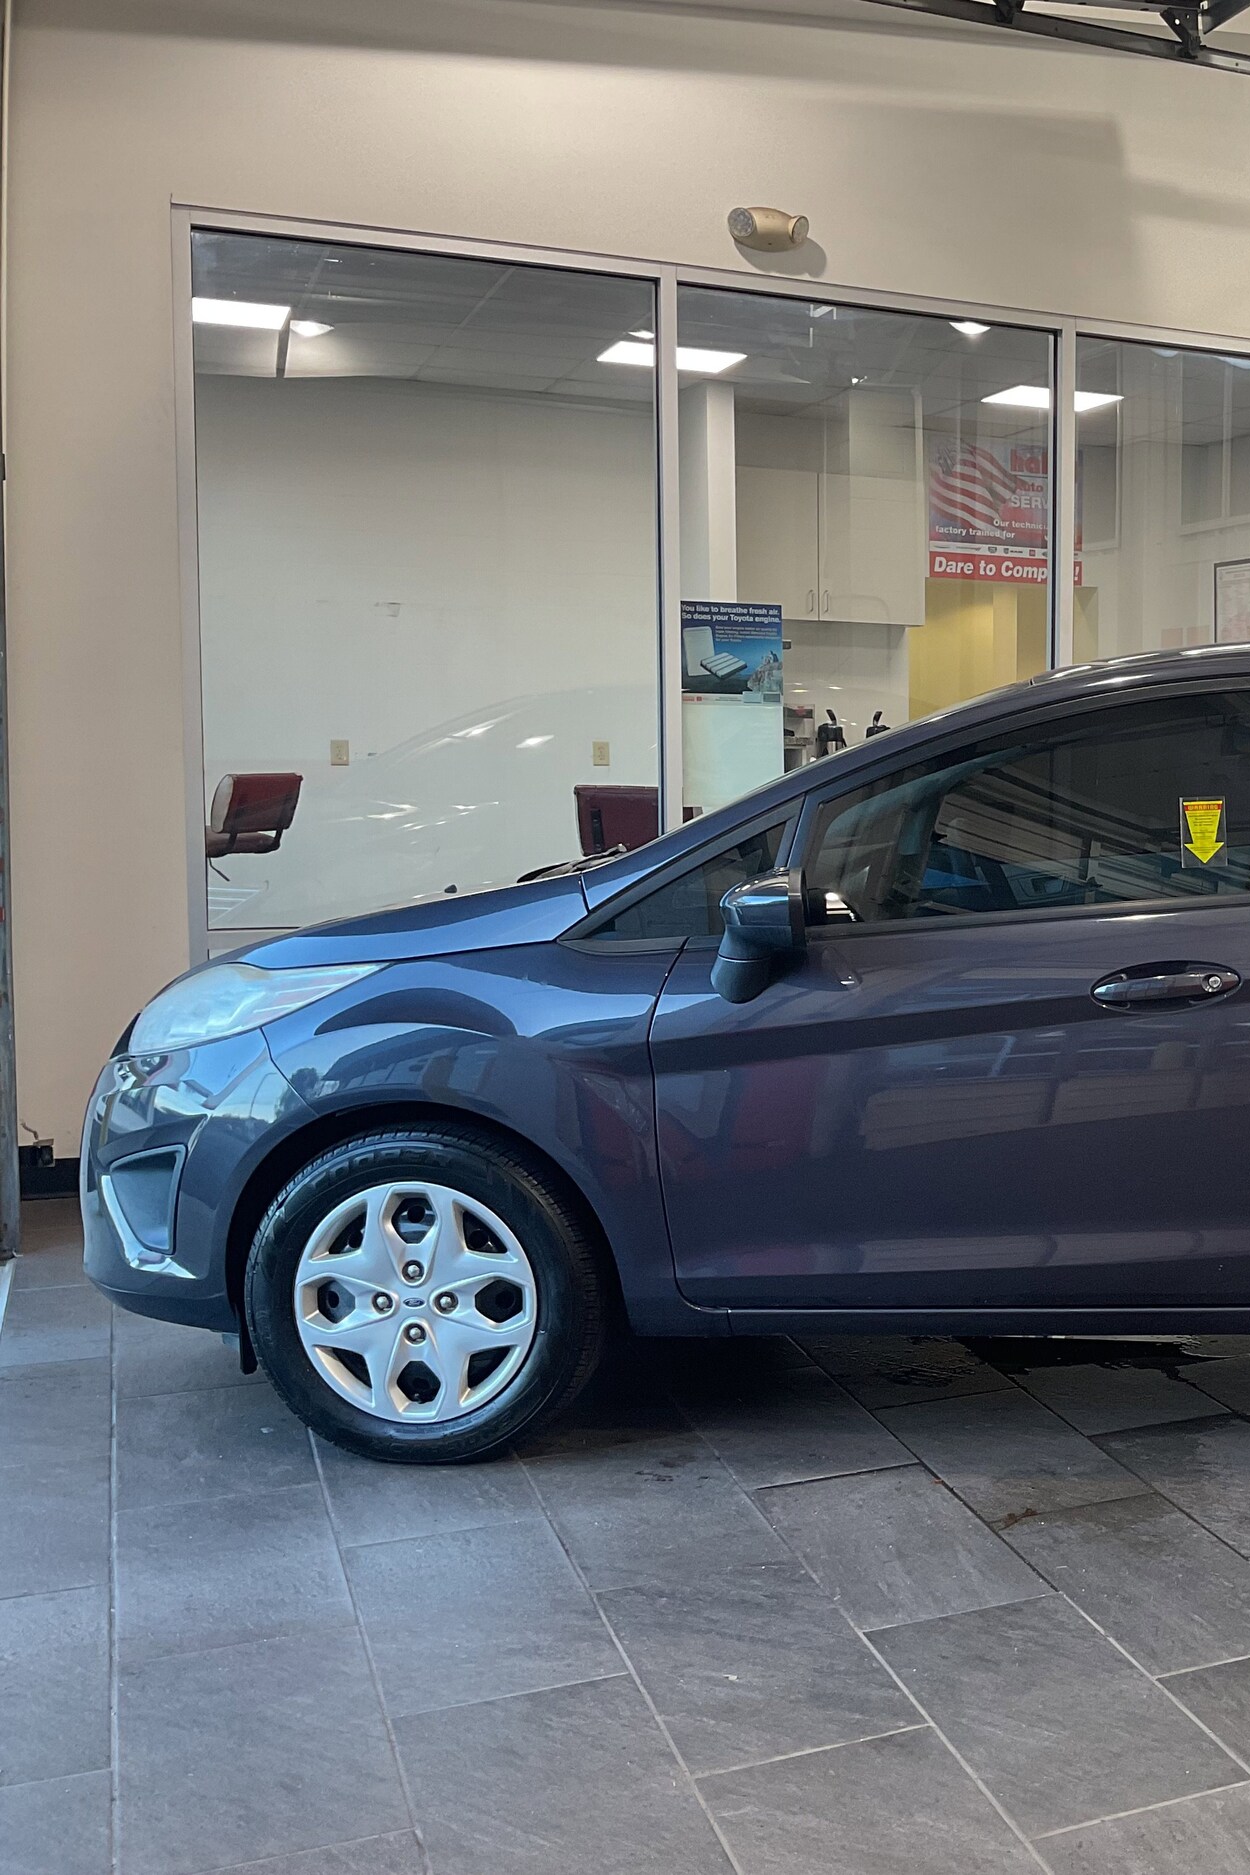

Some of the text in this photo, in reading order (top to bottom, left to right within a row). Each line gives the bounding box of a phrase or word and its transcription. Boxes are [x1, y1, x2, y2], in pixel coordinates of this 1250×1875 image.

[993, 519, 1048, 530] Our technici
[935, 525, 1016, 539] factory trained for
[934, 556, 974, 574] Dare
[979, 560, 997, 576] to
[681, 604, 695, 612] You
[720, 606, 748, 614] breathe
[749, 607, 767, 615] fresh
[712, 614, 729, 622] your
[729, 614, 754, 623] Toyota
[755, 615, 781, 624] engine.
